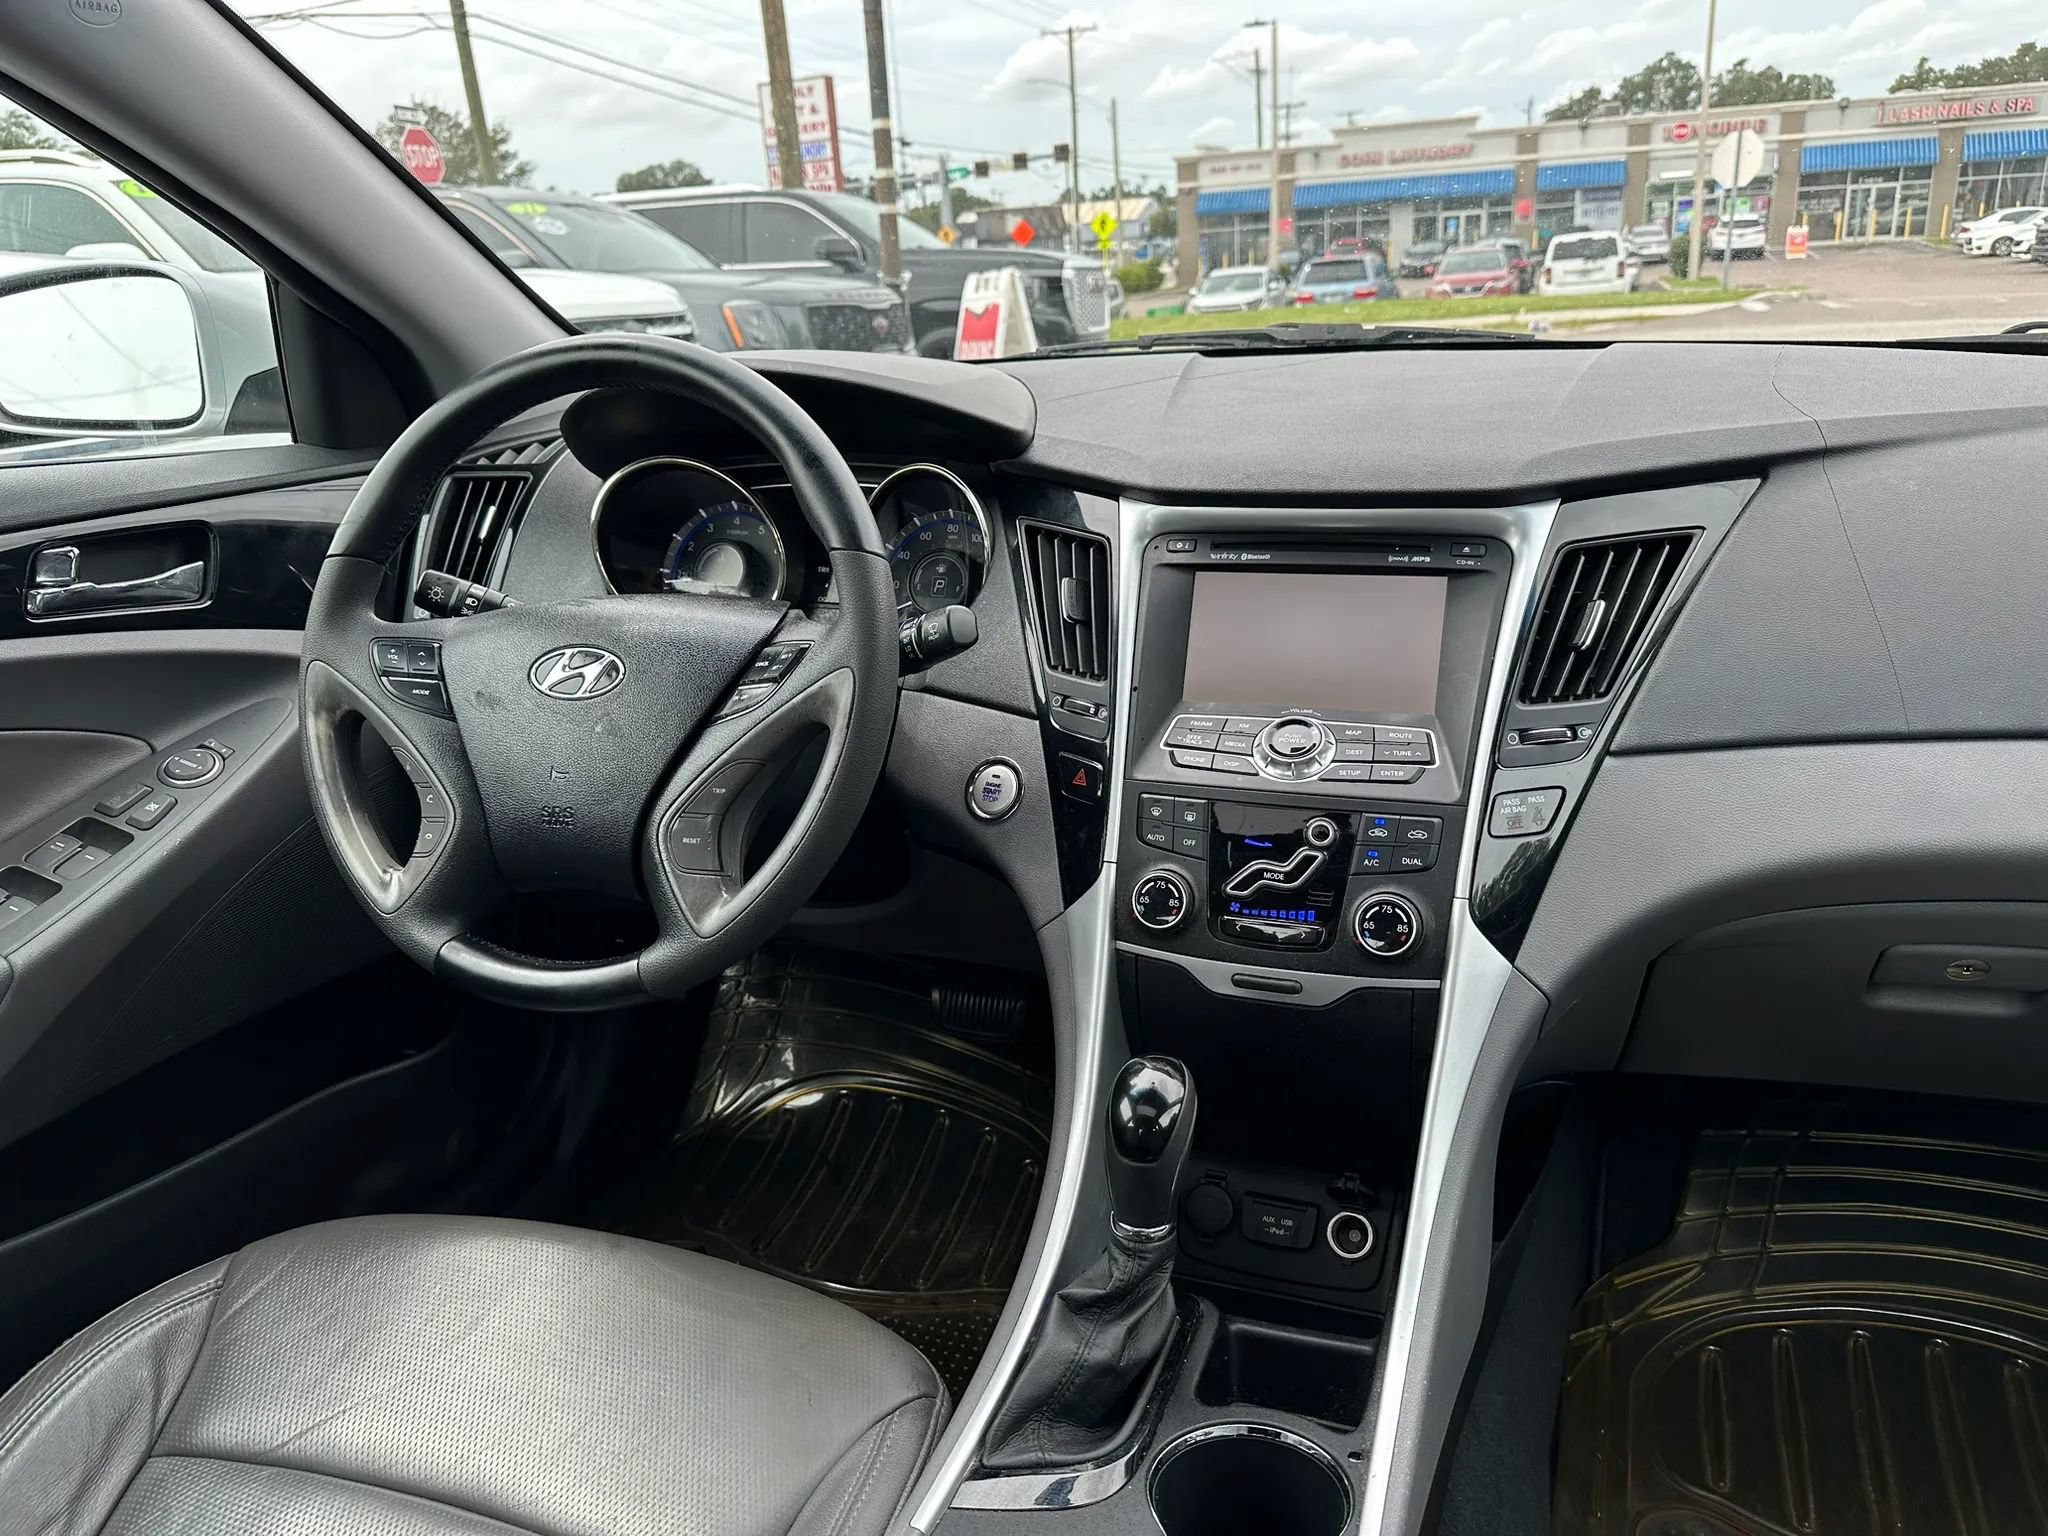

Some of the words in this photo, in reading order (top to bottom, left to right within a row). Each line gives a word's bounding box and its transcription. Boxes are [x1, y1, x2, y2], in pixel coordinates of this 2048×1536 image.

[1888, 104, 1933, 123] LASH
[1937, 101, 1985, 119] NAILS
[1988, 100, 2001, 114] &
[2005, 97, 2036, 113] SPA
[405, 144, 440, 168] STOP
[707, 524, 714, 533] 3
[758, 526, 766, 535] 5
[946, 524, 959, 533] 80
[919, 532, 932, 541] 60
[688, 542, 695, 551] 2
[898, 552, 910, 560] 40
[933, 580, 945, 593] P
[982, 787, 1002, 796] START
[982, 795, 999, 803] STOP
[1503, 798, 1521, 806] PASS
[1527, 795, 1545, 803] PASS
[541, 805, 574, 818] SRS
[1500, 806, 1512, 814] AIR
[1512, 805, 1527, 814] BAG
[1146, 833, 1165, 842] AUTO
[1182, 839, 1197, 847] OFF
[1363, 858, 1379, 867] A/C
[1402, 857, 1424, 866] DUAL
[1263, 871, 1285, 880] MODE
[1155, 881, 1166, 889] 75
[1139, 895, 1150, 903] 65
[1168, 899, 1180, 907] 85
[1381, 905, 1393, 914] 75
[1363, 921, 1375, 930] 65
[1397, 924, 1409, 933] 85
[1262, 1215, 1275, 1224] AUX
[1280, 1218, 1294, 1227] USB
